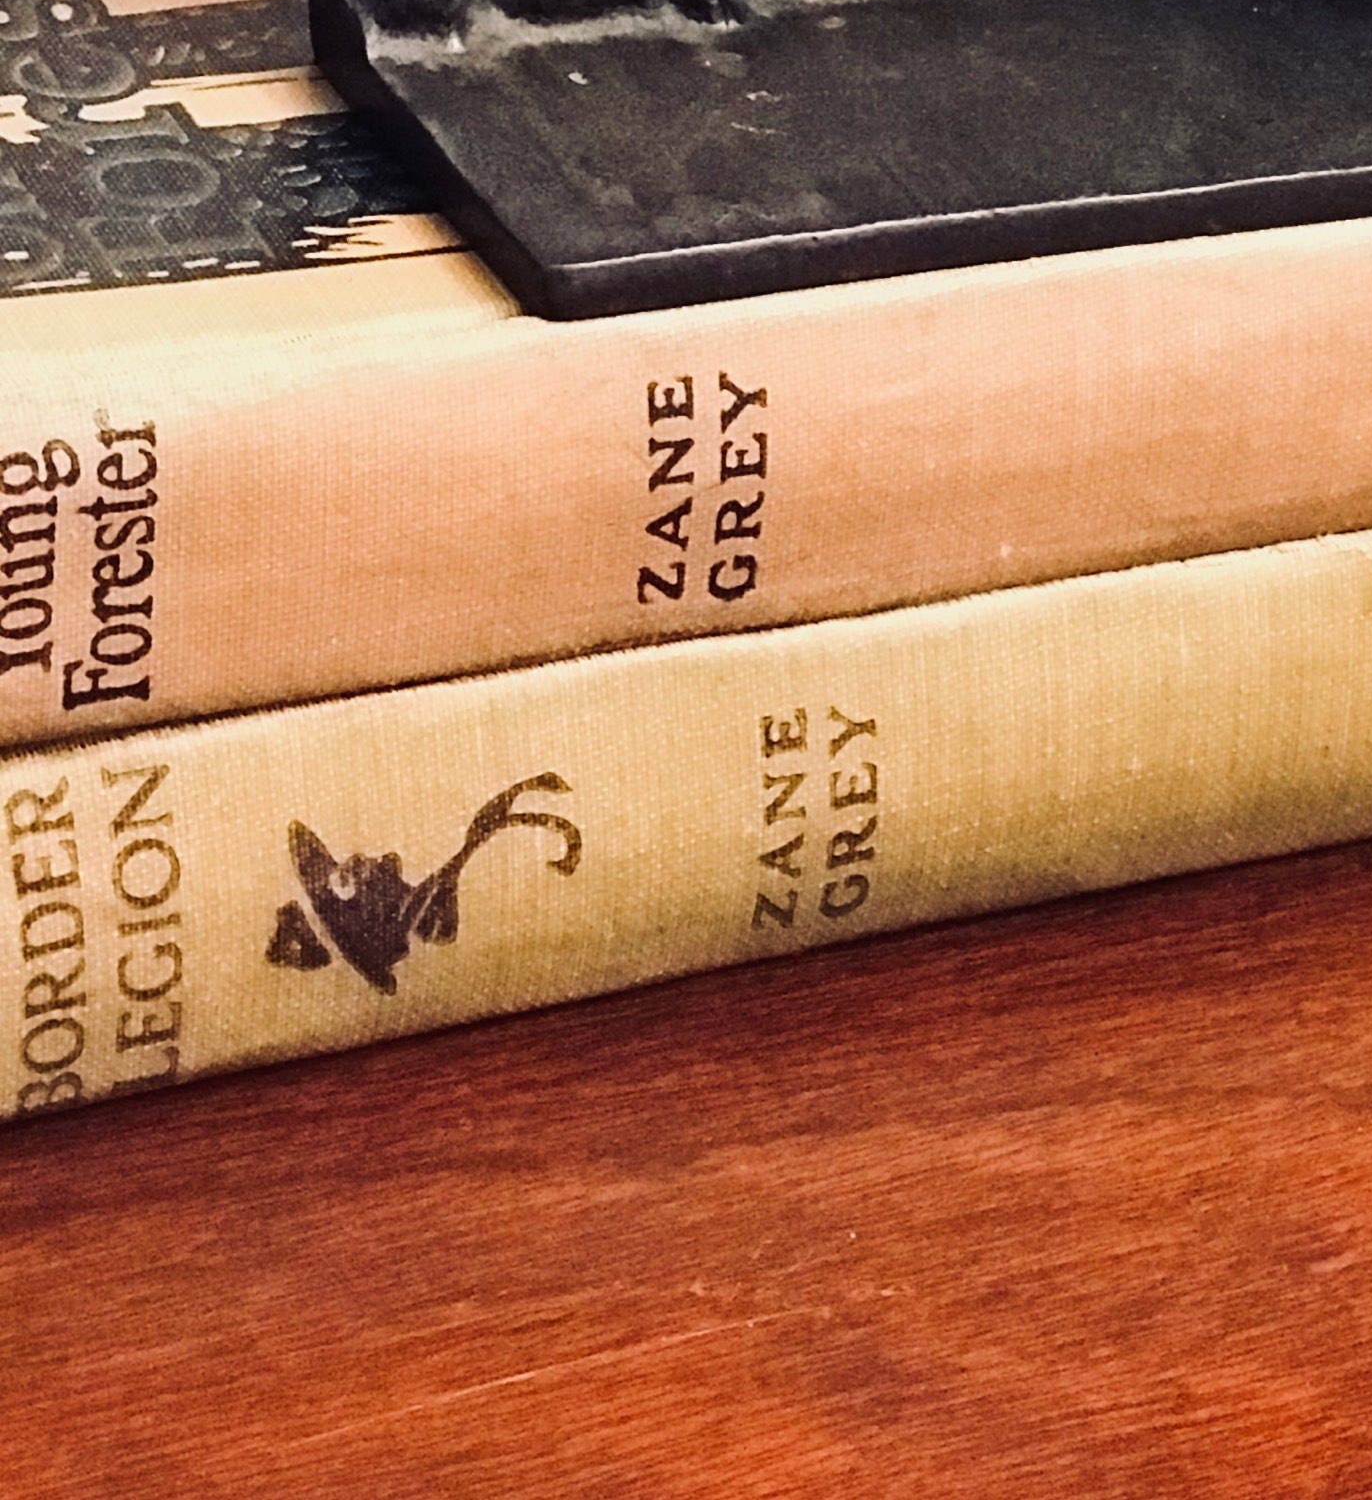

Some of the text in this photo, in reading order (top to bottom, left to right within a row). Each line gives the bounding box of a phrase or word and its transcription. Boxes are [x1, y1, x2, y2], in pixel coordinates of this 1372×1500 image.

[62, 408, 157, 710] Forester
[637, 375, 694, 604] ZANE
[708, 371, 768, 602] GREY
[752, 706, 807, 932] ZANE
[819, 706, 877, 919] GREY
[4, 776, 85, 1114] BORDER
[102, 764, 182, 1098] LEGION
